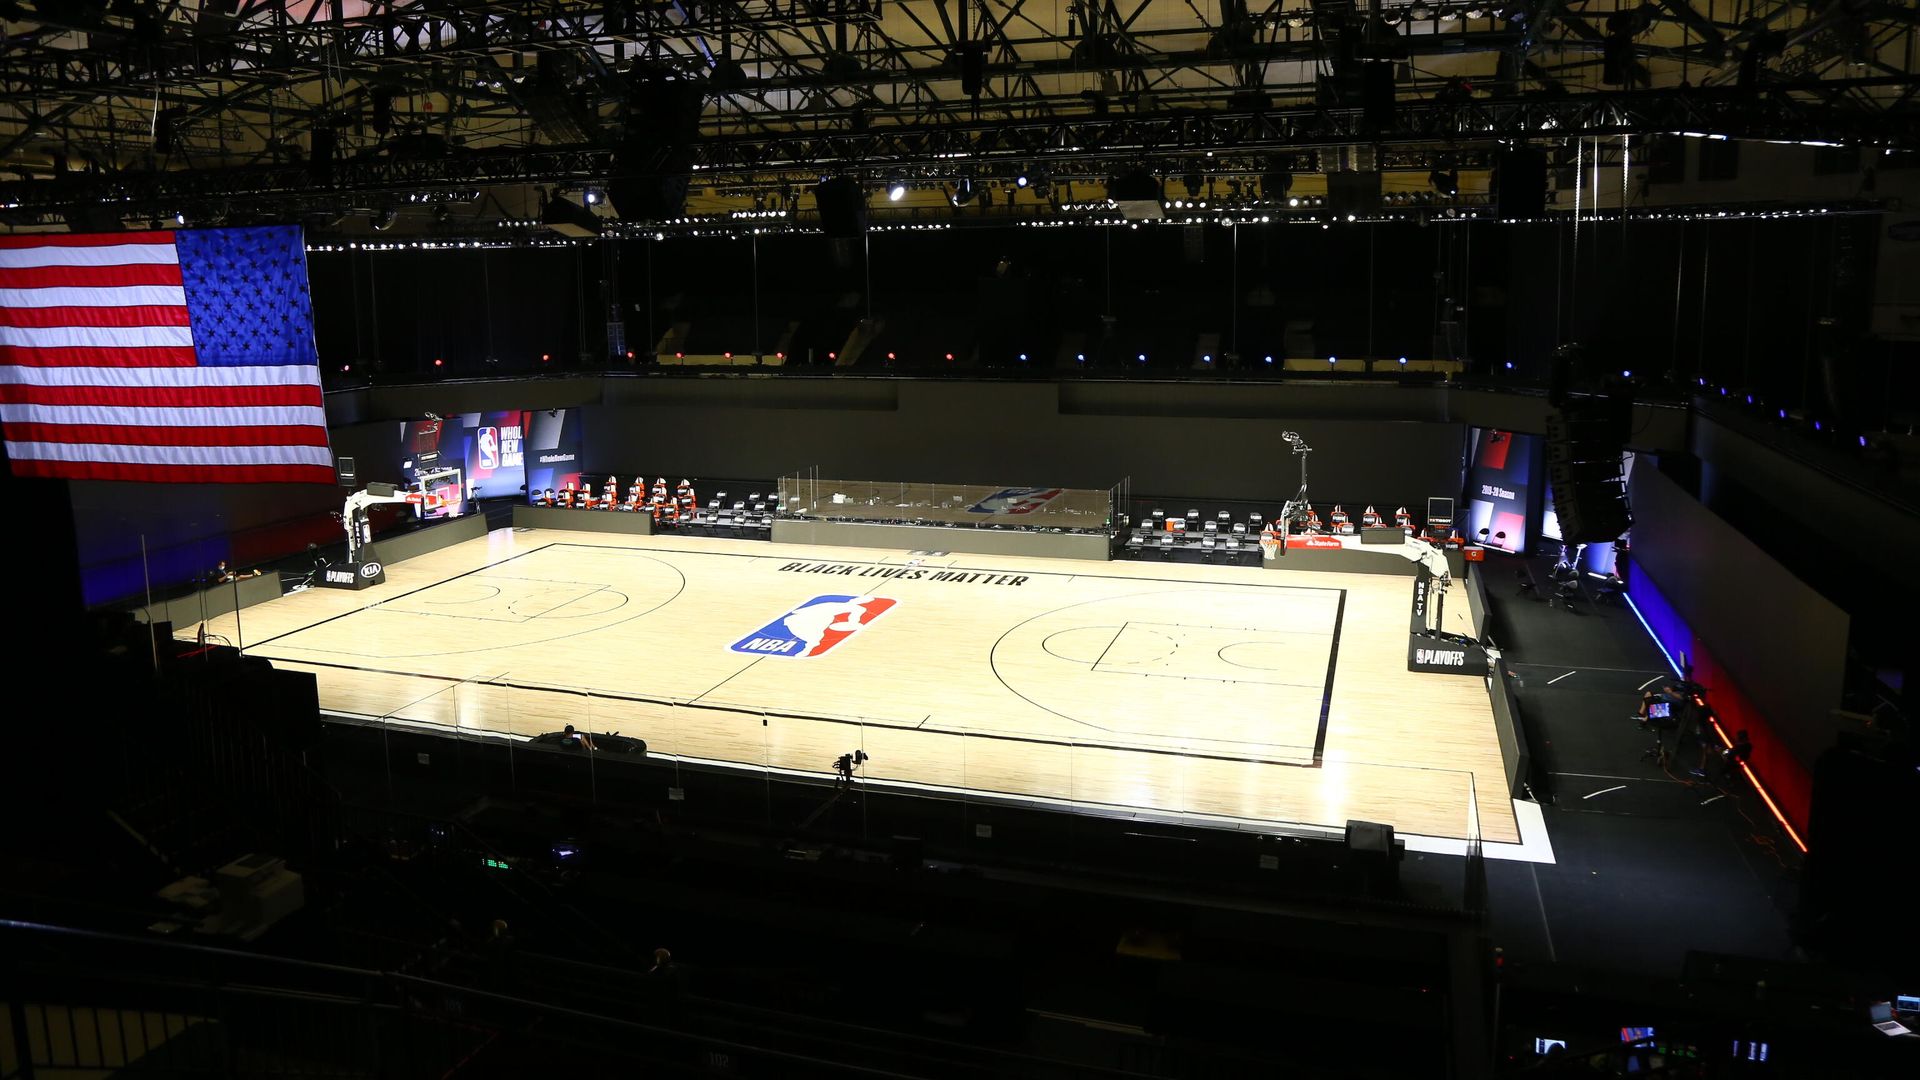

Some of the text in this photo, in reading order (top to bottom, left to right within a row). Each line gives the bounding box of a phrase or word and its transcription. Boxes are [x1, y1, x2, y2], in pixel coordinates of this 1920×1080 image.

[502, 440, 518, 453] NEW
[502, 453, 524, 467] GAME
[363, 565, 378, 575] KIA
[778, 562, 1030, 587] BLACK LIVES MATTER
[330, 571, 355, 584] PLAYOFFS
[1416, 603, 1423, 616] TV
[741, 637, 798, 653] NBA
[1424, 649, 1465, 667] PLAYOFFS
